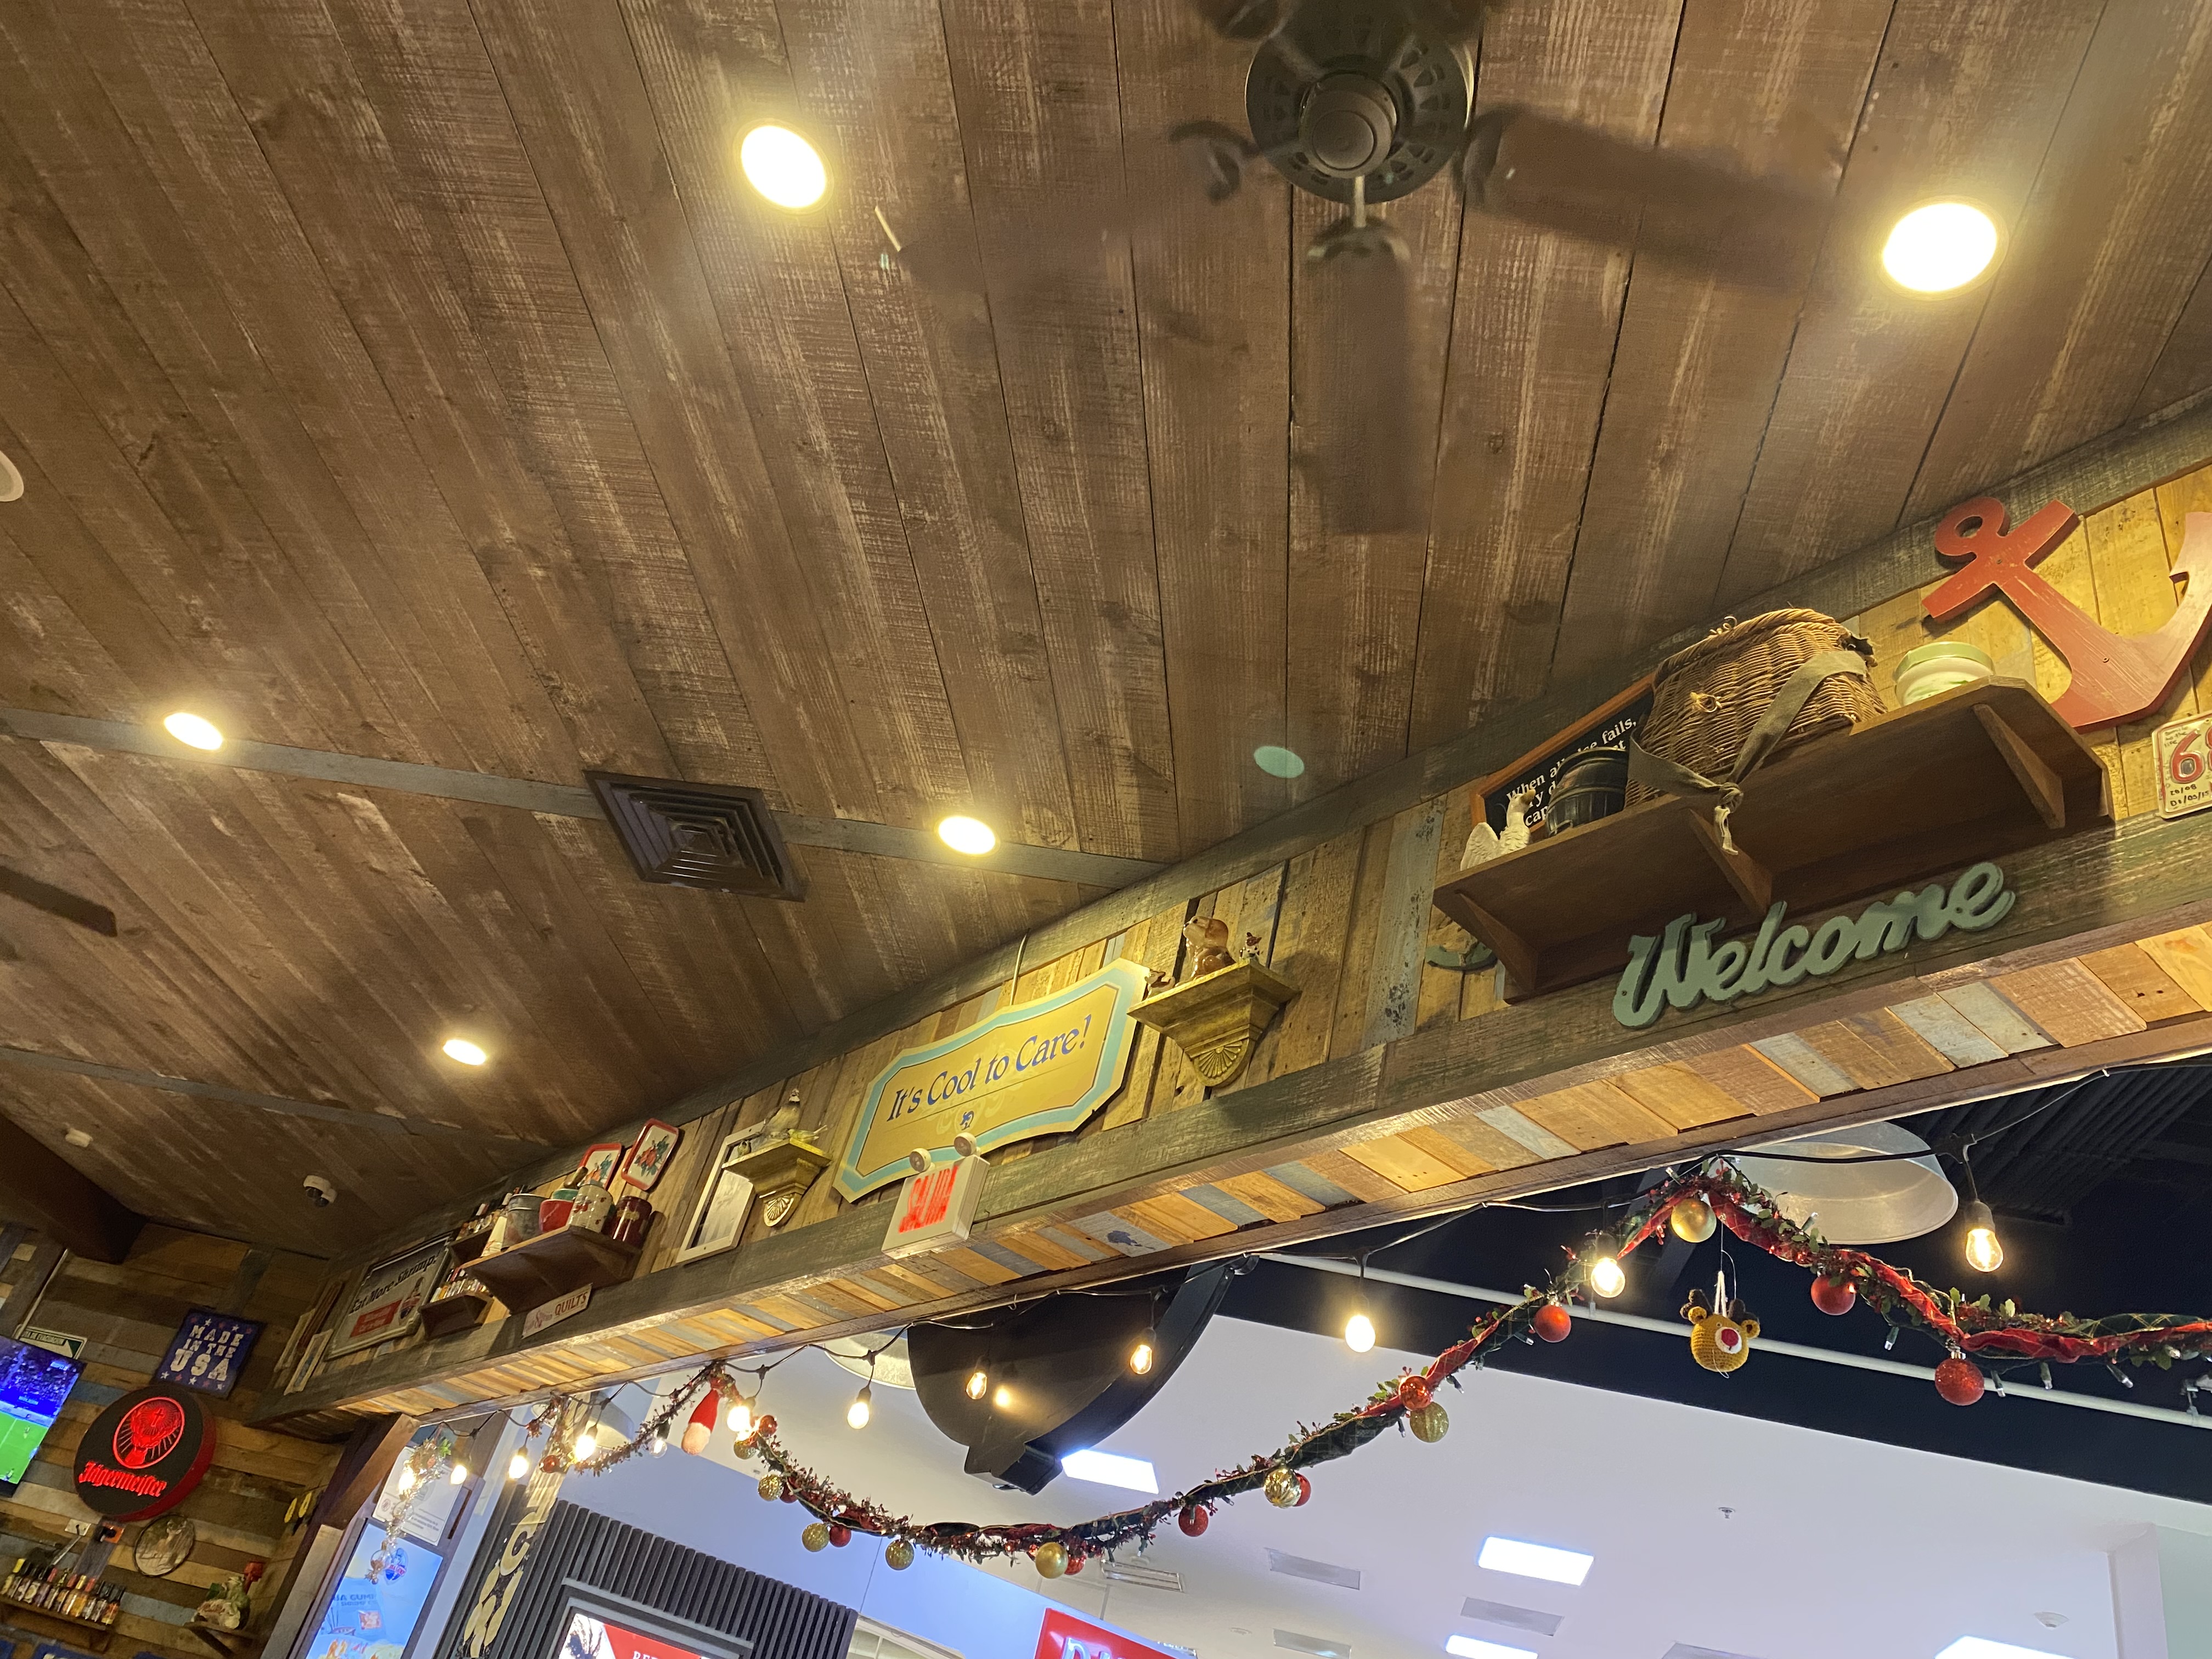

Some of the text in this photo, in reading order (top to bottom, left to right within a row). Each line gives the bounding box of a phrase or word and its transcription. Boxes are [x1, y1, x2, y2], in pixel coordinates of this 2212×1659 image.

[1506, 775, 1545, 800] When
[1601, 718, 1637, 744] fails,
[1525, 805, 1548, 827] cap
[1612, 861, 2016, 1029] Welcome
[886, 1013, 1092, 1122] It's Cool to Care!
[349, 1298, 368, 1314] Eat
[366, 1281, 395, 1306] More
[554, 1291, 588, 1316] QUILTS
[183, 1338, 237, 1359] IN THE
[189, 1325, 244, 1347] MADE
[170, 1348, 229, 1381] USA
